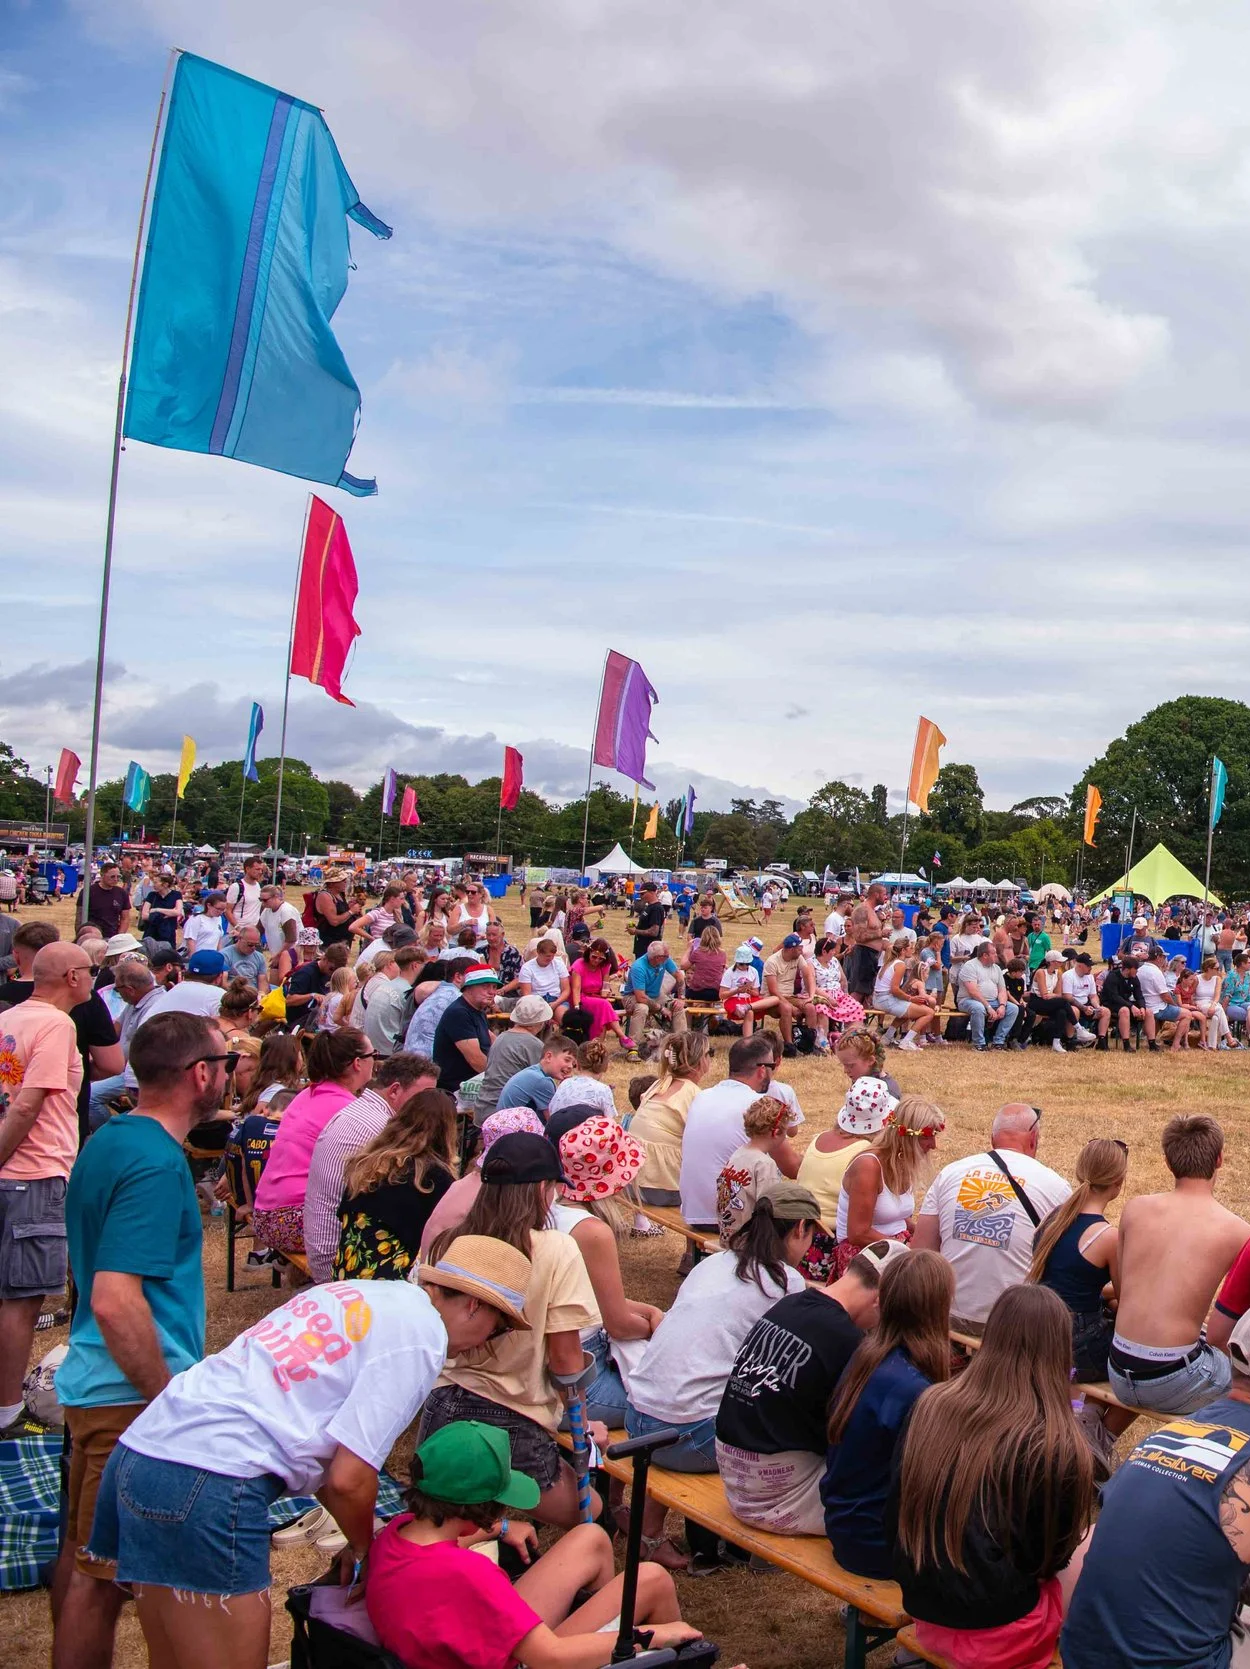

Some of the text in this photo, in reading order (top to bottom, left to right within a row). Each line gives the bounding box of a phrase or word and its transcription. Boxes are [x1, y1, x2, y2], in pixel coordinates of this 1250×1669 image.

[966, 1170, 981, 1178] LA
[325, 1283, 364, 1309] un
[1151, 1466, 1188, 1482] COLLECTION
